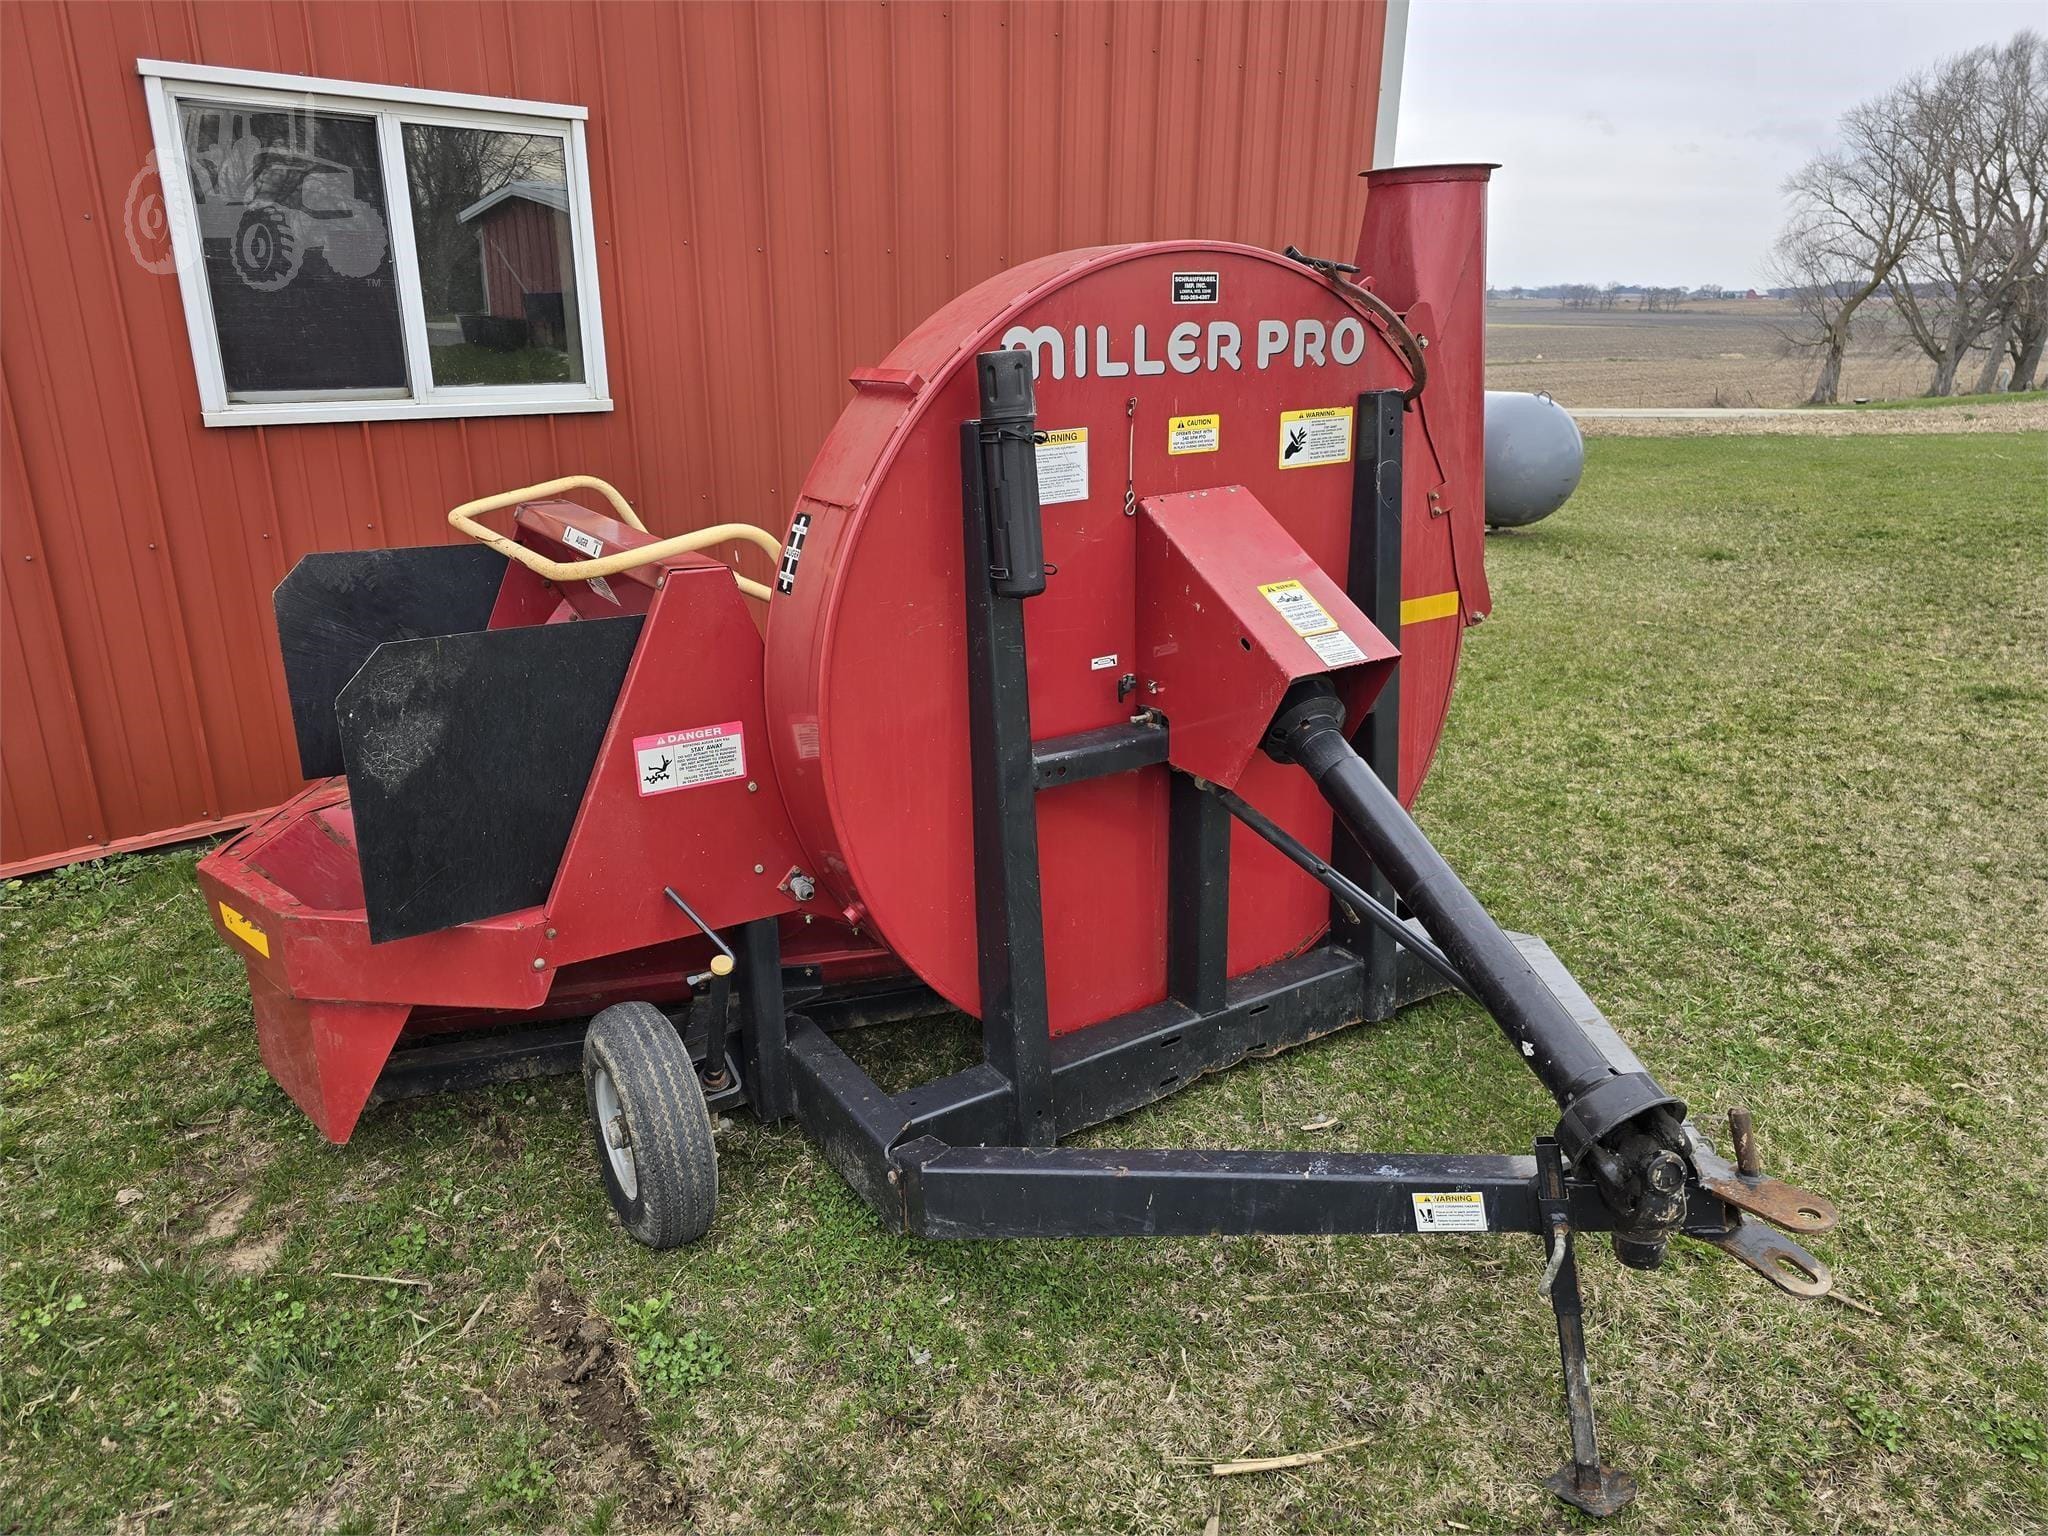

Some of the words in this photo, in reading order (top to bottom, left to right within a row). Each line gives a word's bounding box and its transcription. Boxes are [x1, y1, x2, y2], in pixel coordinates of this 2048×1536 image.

[1001, 320, 1243, 381] MILLER
[1257, 316, 1366, 370] PRO
[1045, 432, 1078, 444] ARNING
[667, 727, 721, 743] DANGER
